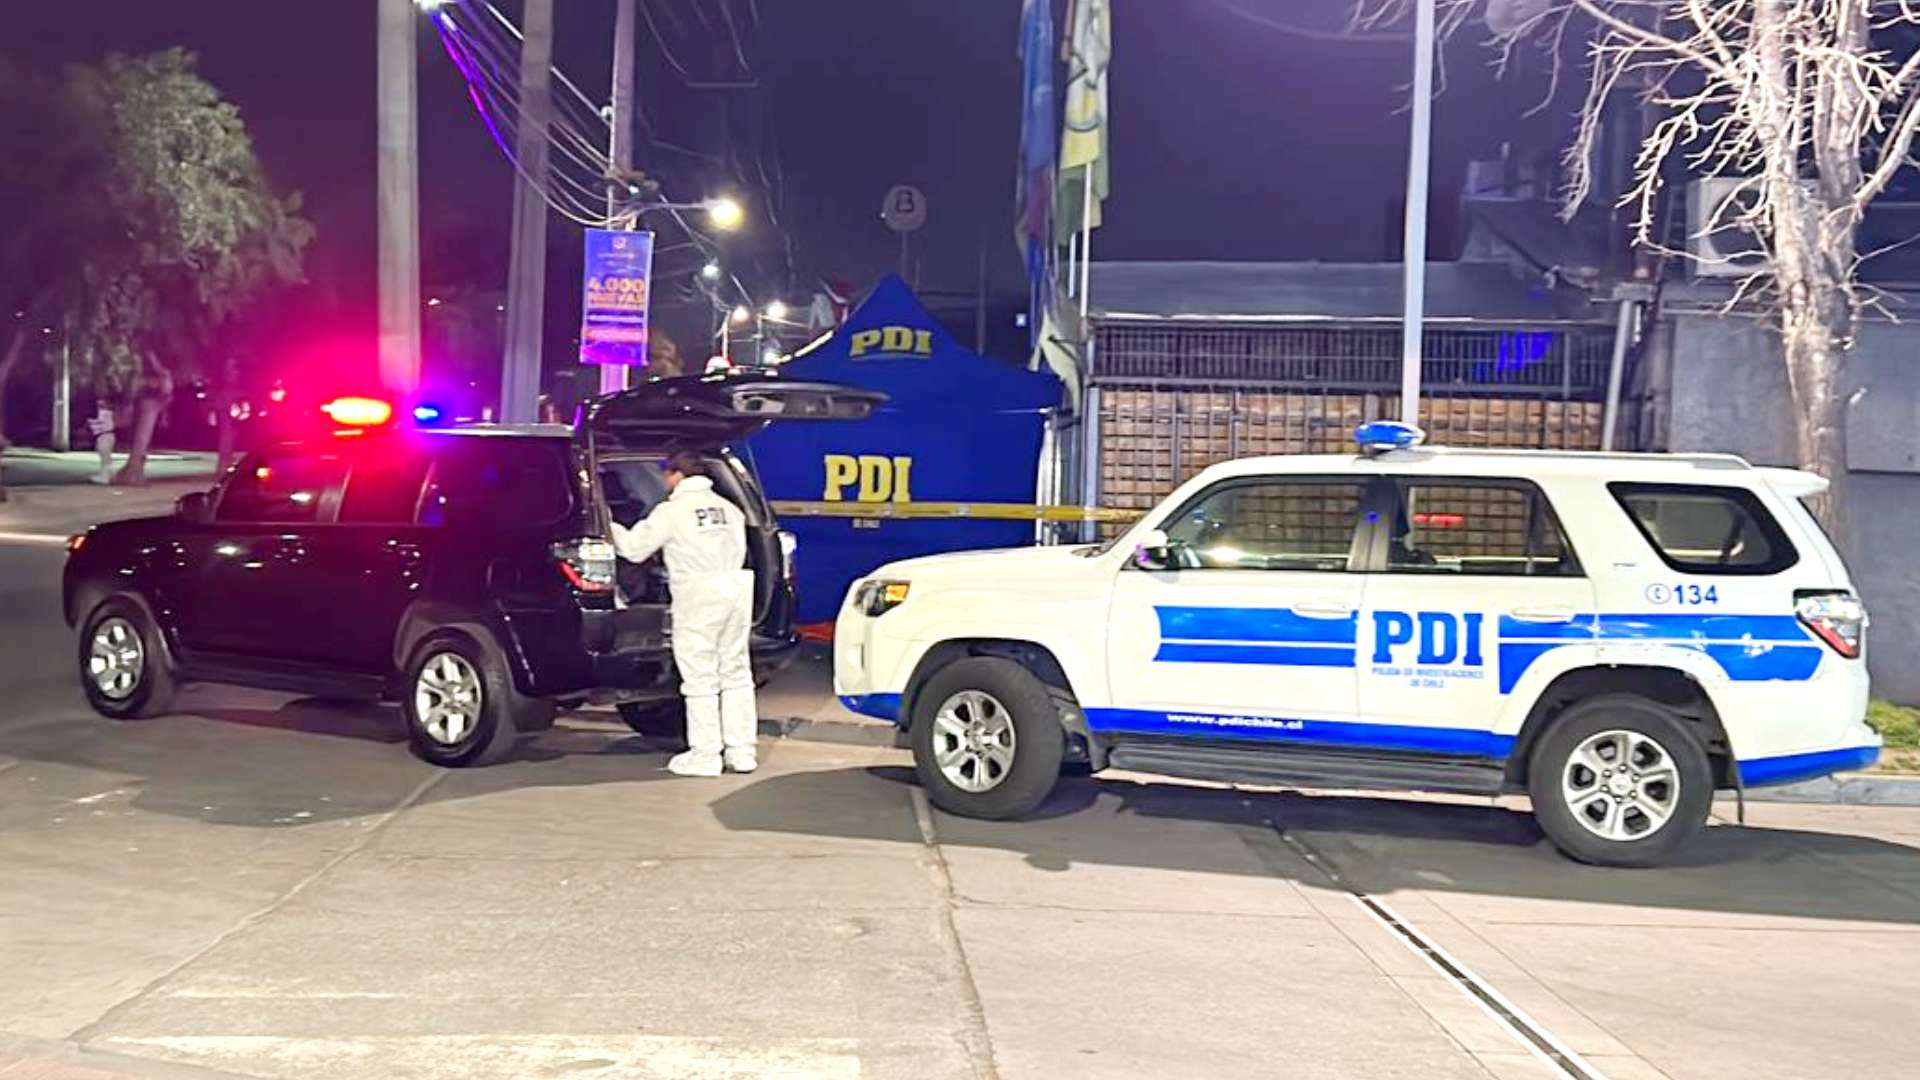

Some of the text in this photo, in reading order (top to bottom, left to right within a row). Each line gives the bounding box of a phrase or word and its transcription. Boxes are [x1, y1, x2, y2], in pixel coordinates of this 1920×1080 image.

[849, 326, 932, 356] PDI
[823, 455, 912, 503] PDI
[695, 507, 727, 527] PDI
[1673, 584, 1719, 605] 134
[1372, 611, 1484, 666] PDI
[1166, 713, 1304, 730] www.pdichile.cl
